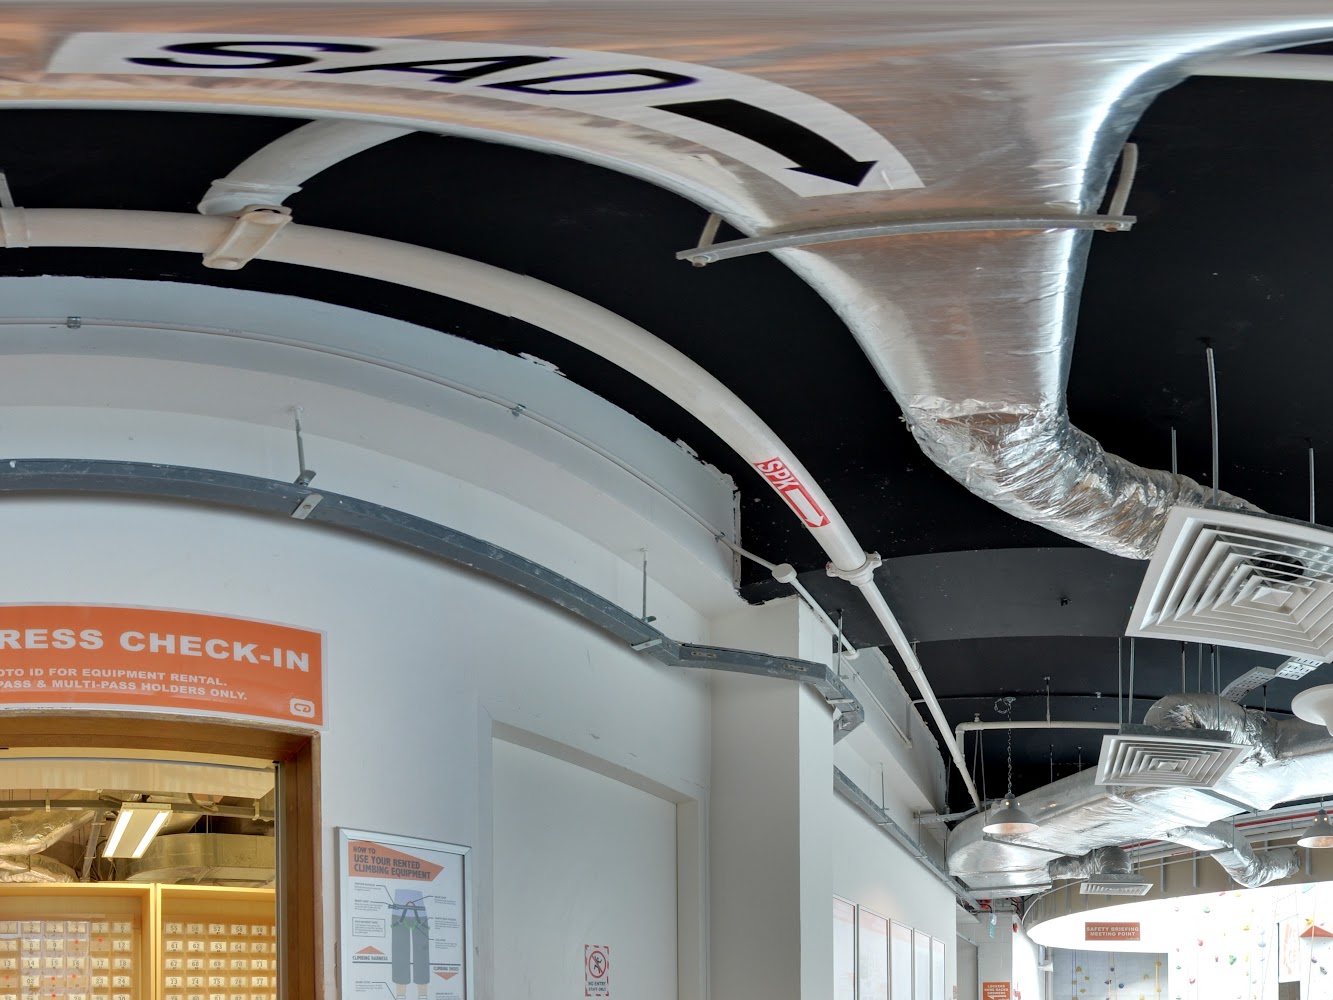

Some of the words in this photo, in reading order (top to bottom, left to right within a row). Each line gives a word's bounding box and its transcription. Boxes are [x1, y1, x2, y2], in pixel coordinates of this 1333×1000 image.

[125, 39, 700, 97] SAD
[758, 460, 800, 490] SPK
[0, 629, 103, 649] RESS
[120, 631, 309, 672] CHECK-IN
[49, 668, 77, 676] FOR
[82, 669, 165, 680] EQUIPMENT
[171, 674, 227, 686] RENTAL.
[37, 680, 46, 688] &
[52, 680, 136, 690] MULTI-PASS
[141, 682, 205, 695] HOLDERS
[210, 688, 248, 700] ONLY.
[354, 854, 368, 863] USE
[371, 856, 390, 865] YOUR
[393, 859, 420, 869] RENTED
[354, 864, 389, 874] CLIMBING
[391, 868, 431, 879] EQUIPMENT
